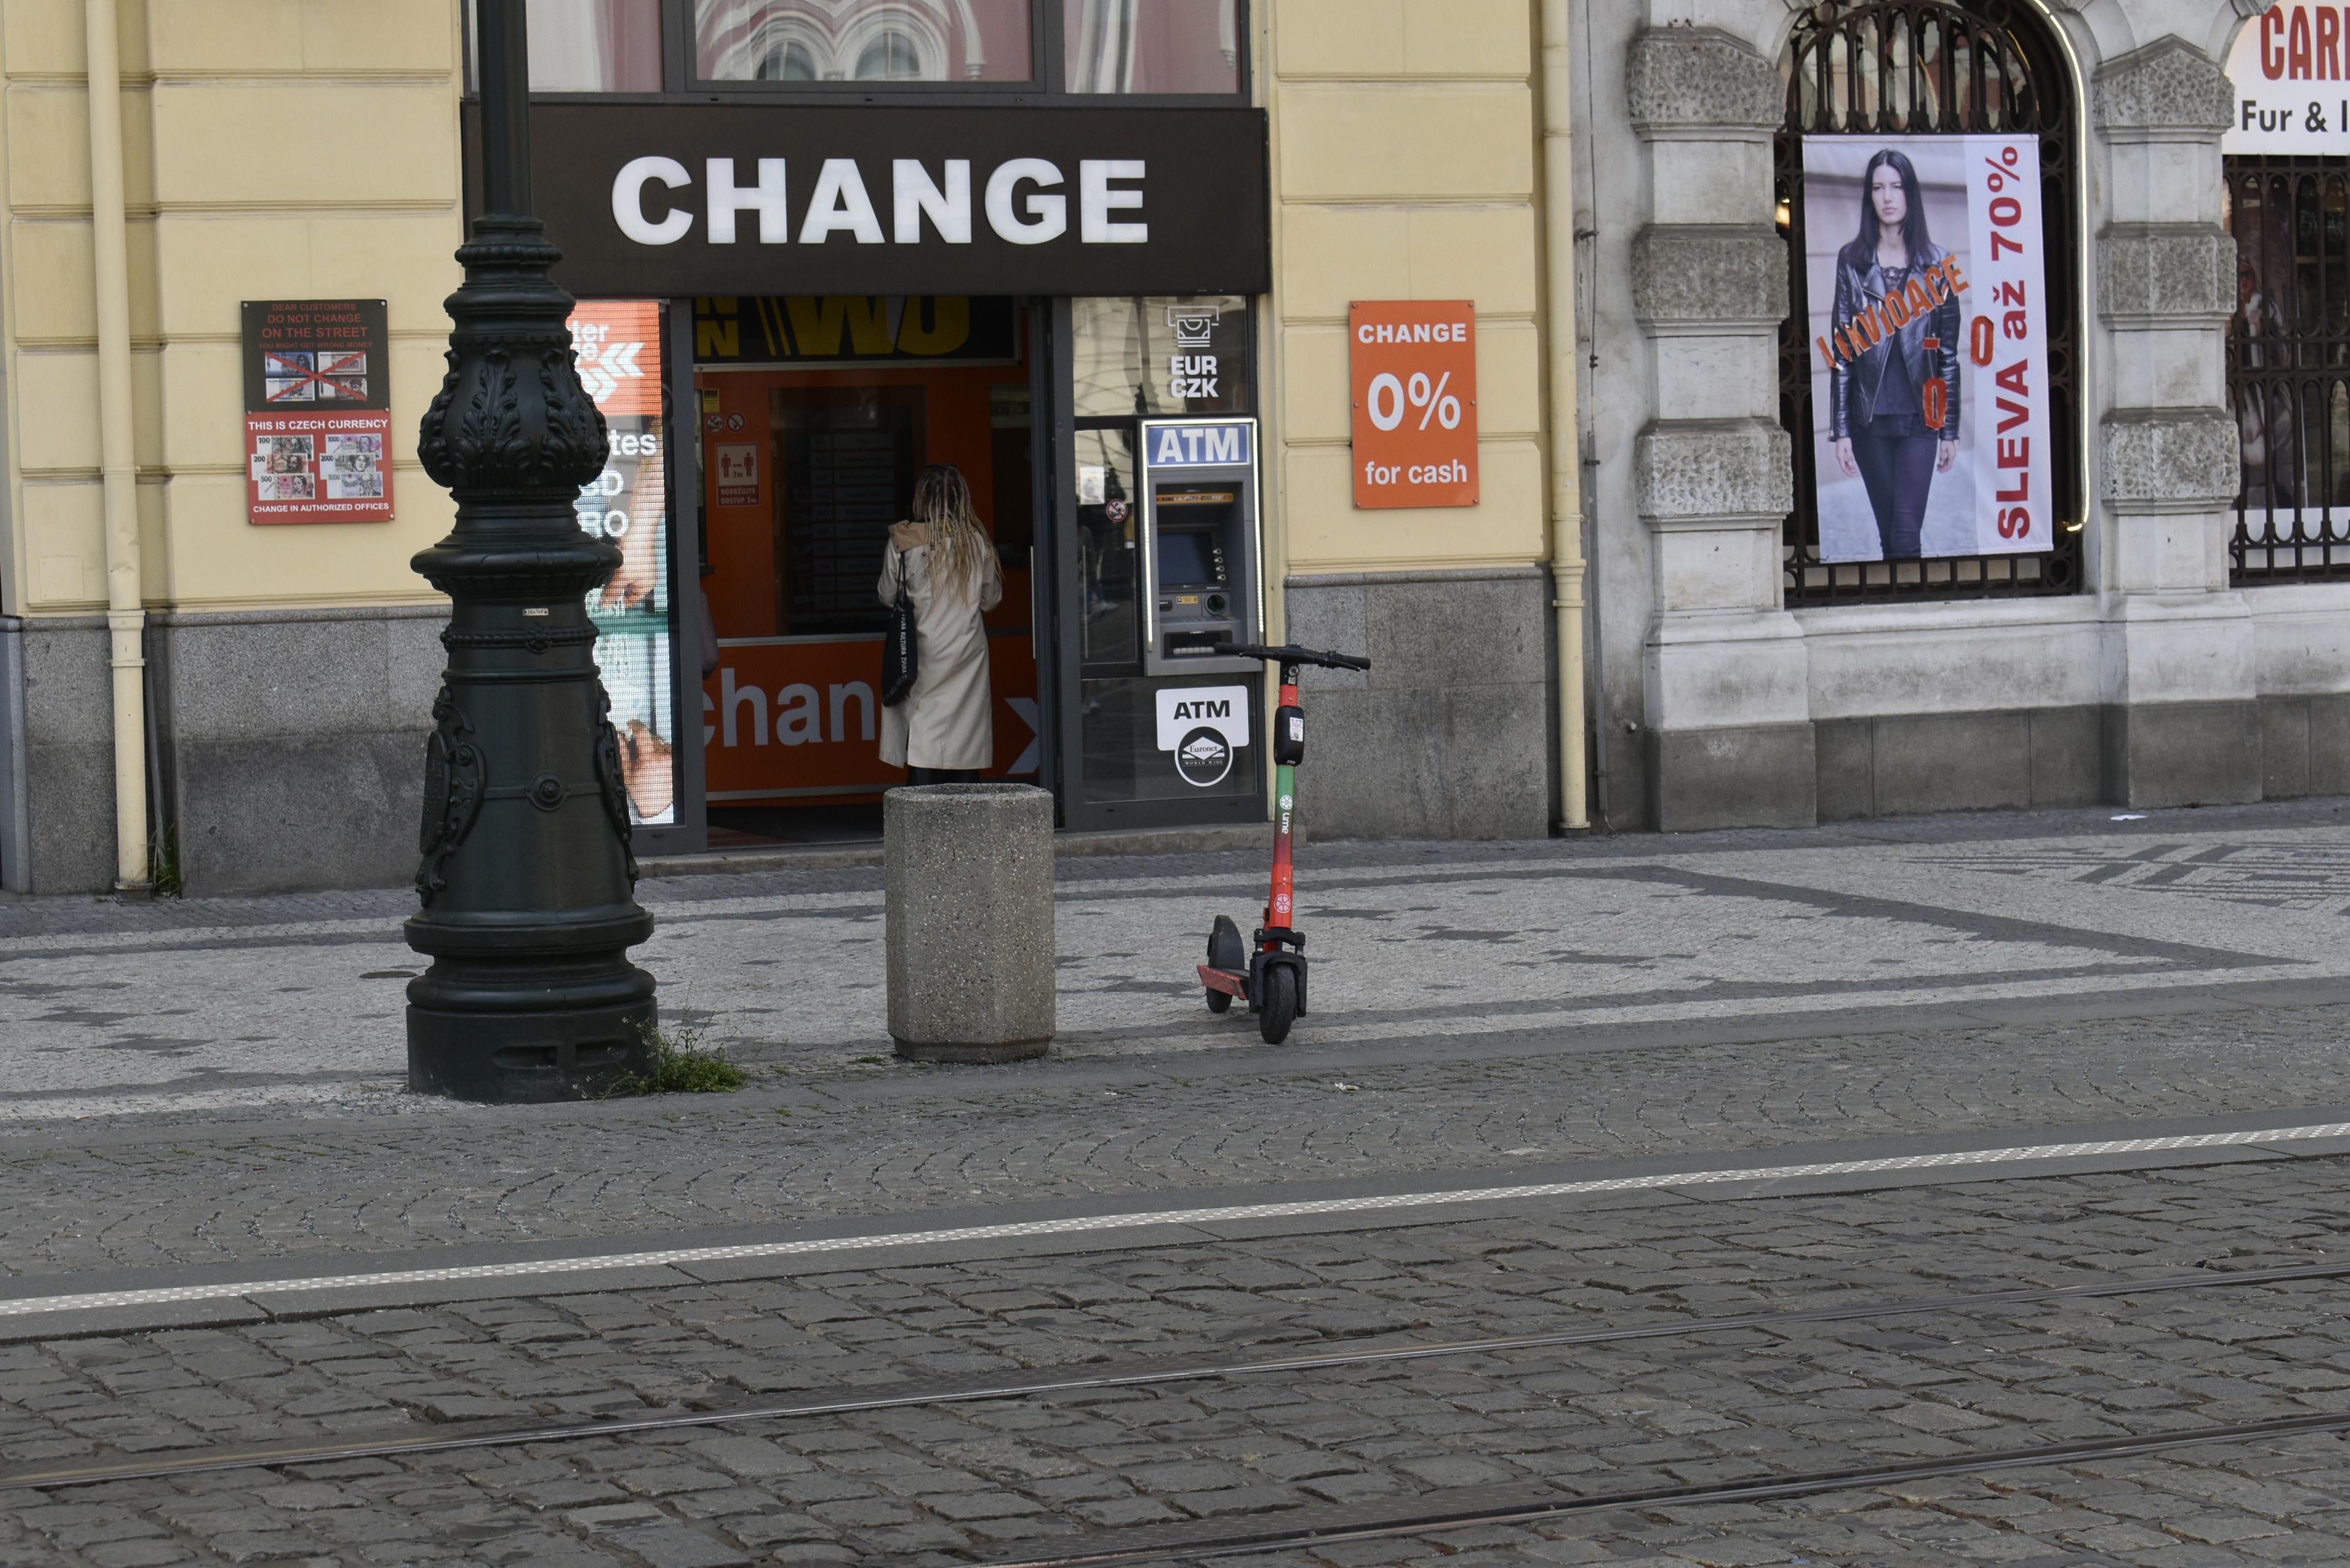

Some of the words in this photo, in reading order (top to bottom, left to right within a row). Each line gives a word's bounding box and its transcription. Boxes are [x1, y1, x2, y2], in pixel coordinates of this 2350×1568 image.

[2261, 5, 2350, 80] CAR
[2242, 100, 2292, 132] Fur
[2305, 102, 2328, 133] &
[612, 156, 1148, 244] CHANGE
[1985, 146, 2024, 262] 70%
[268, 315, 284, 324] DO
[288, 314, 310, 323] NOT
[314, 314, 361, 323] CHANGE
[1993, 280, 2028, 340] až
[262, 328, 281, 338] ON
[286, 328, 311, 338] THE
[317, 327, 368, 337] STREET
[1358, 323, 1466, 344] CHANGE
[1171, 356, 1217, 375] EUR
[1171, 378, 1218, 398] CZK
[1368, 371, 1461, 431] 0%
[249, 421, 273, 430] THIS
[276, 421, 286, 429] IS
[288, 420, 325, 429] CZECH
[328, 419, 388, 429] CURRENCY
[609, 429, 657, 456] tes
[1157, 428, 1239, 463] ATM
[1996, 358, 2030, 539] SLEVA
[1365, 461, 1401, 485] for
[1408, 459, 1468, 485] cash
[721, 487, 756, 495] DODRŽUJTE
[300, 503, 352, 512] AUTHORIZED
[1173, 700, 1230, 720] ATM
